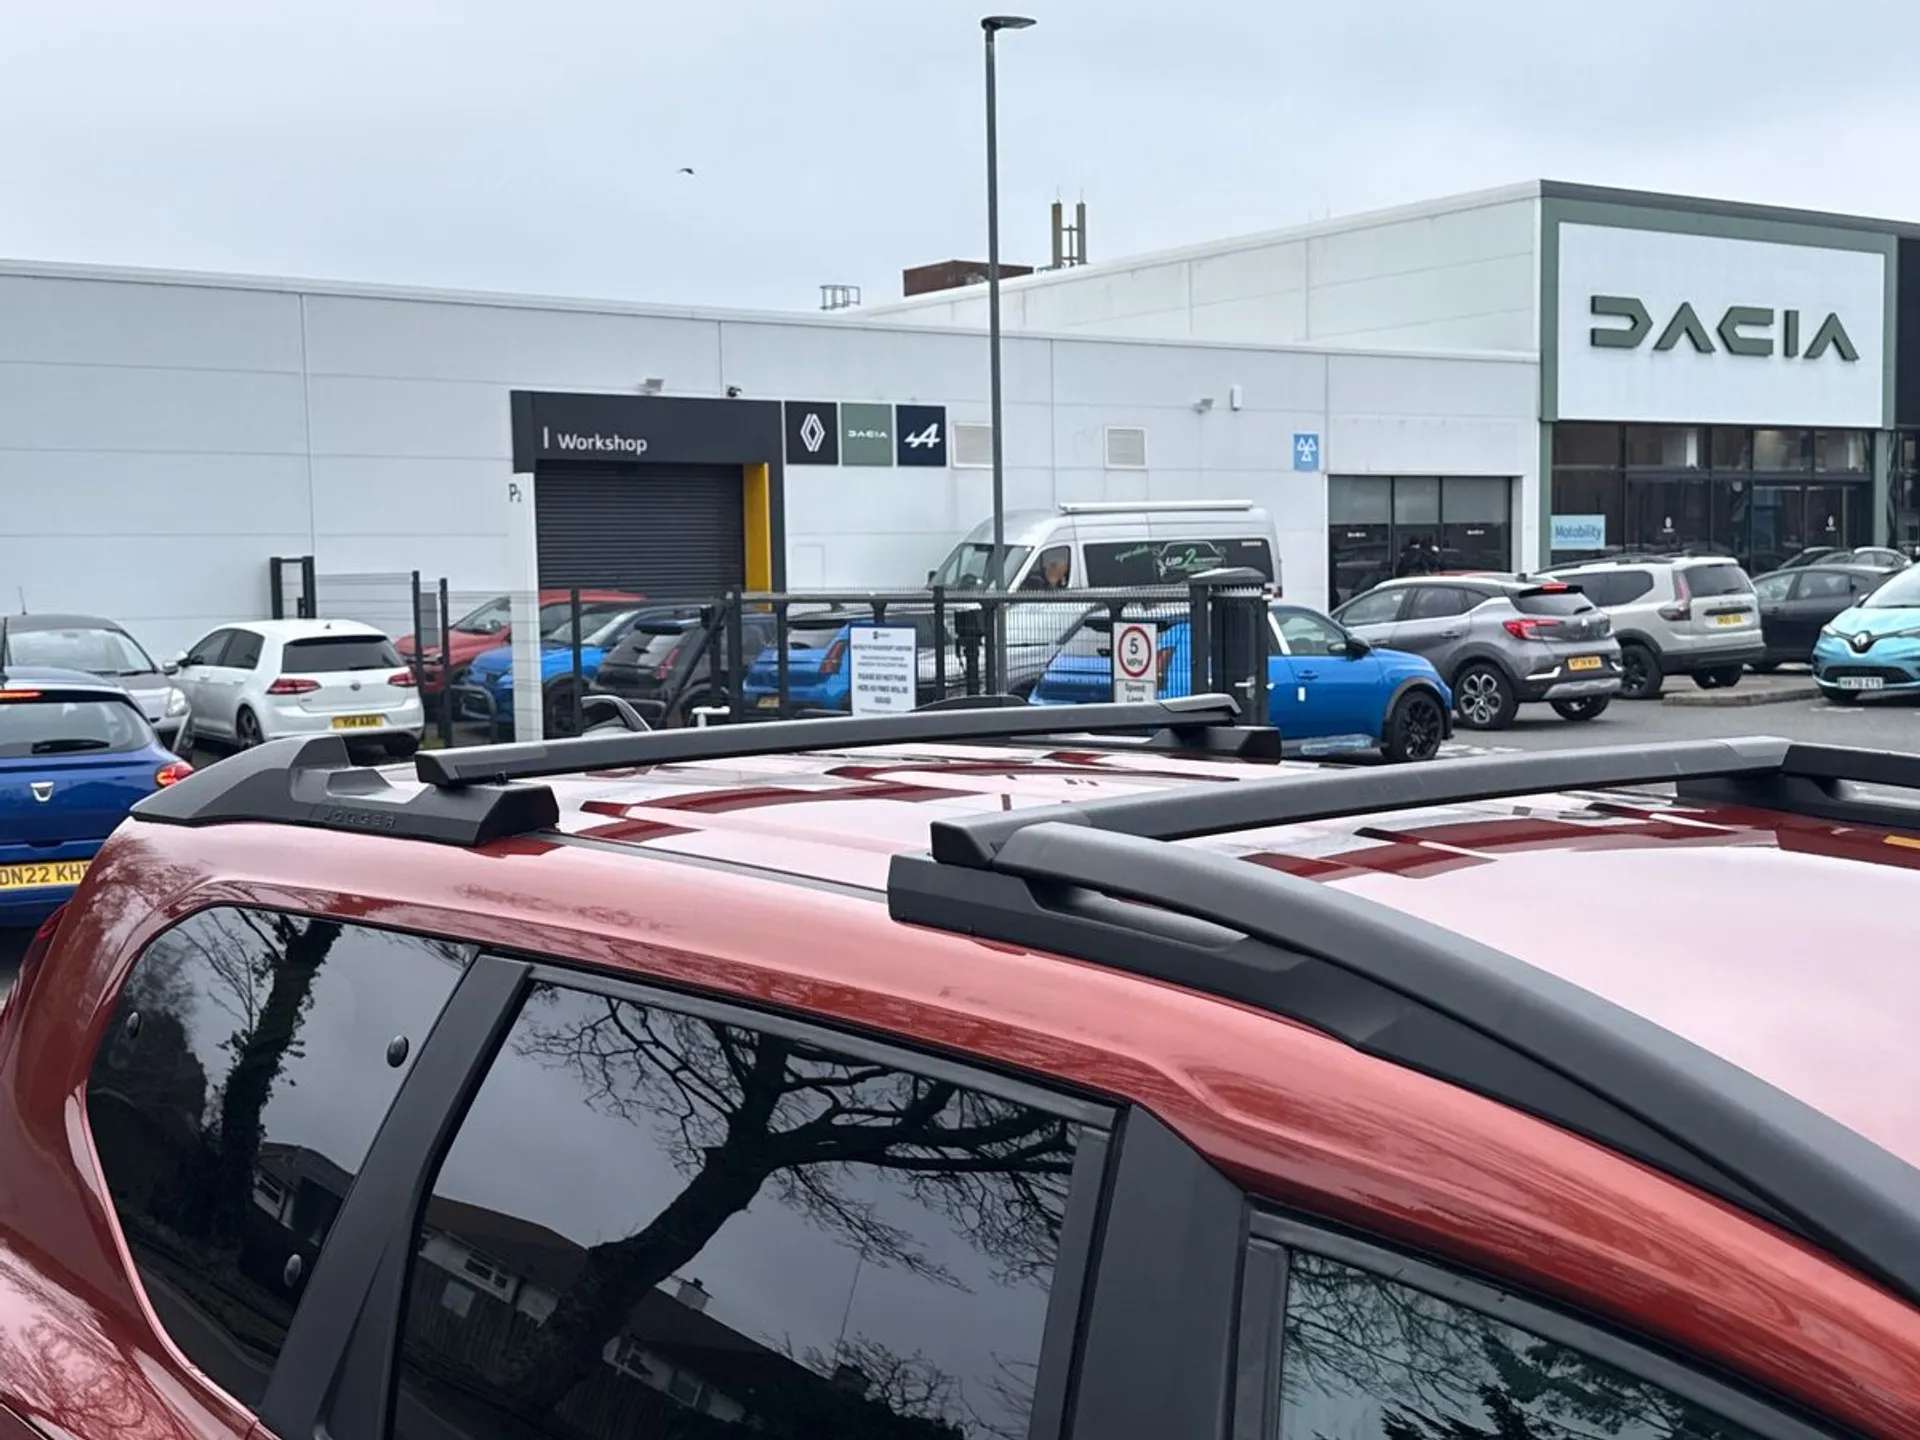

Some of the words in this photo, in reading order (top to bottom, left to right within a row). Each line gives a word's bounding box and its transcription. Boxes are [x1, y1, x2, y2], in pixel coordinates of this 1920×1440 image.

[1590, 295, 1860, 361] DACIA
[847, 429, 888, 439] DACIA
[557, 433, 648, 456] Workshop
[1129, 637, 1139, 655] 5
